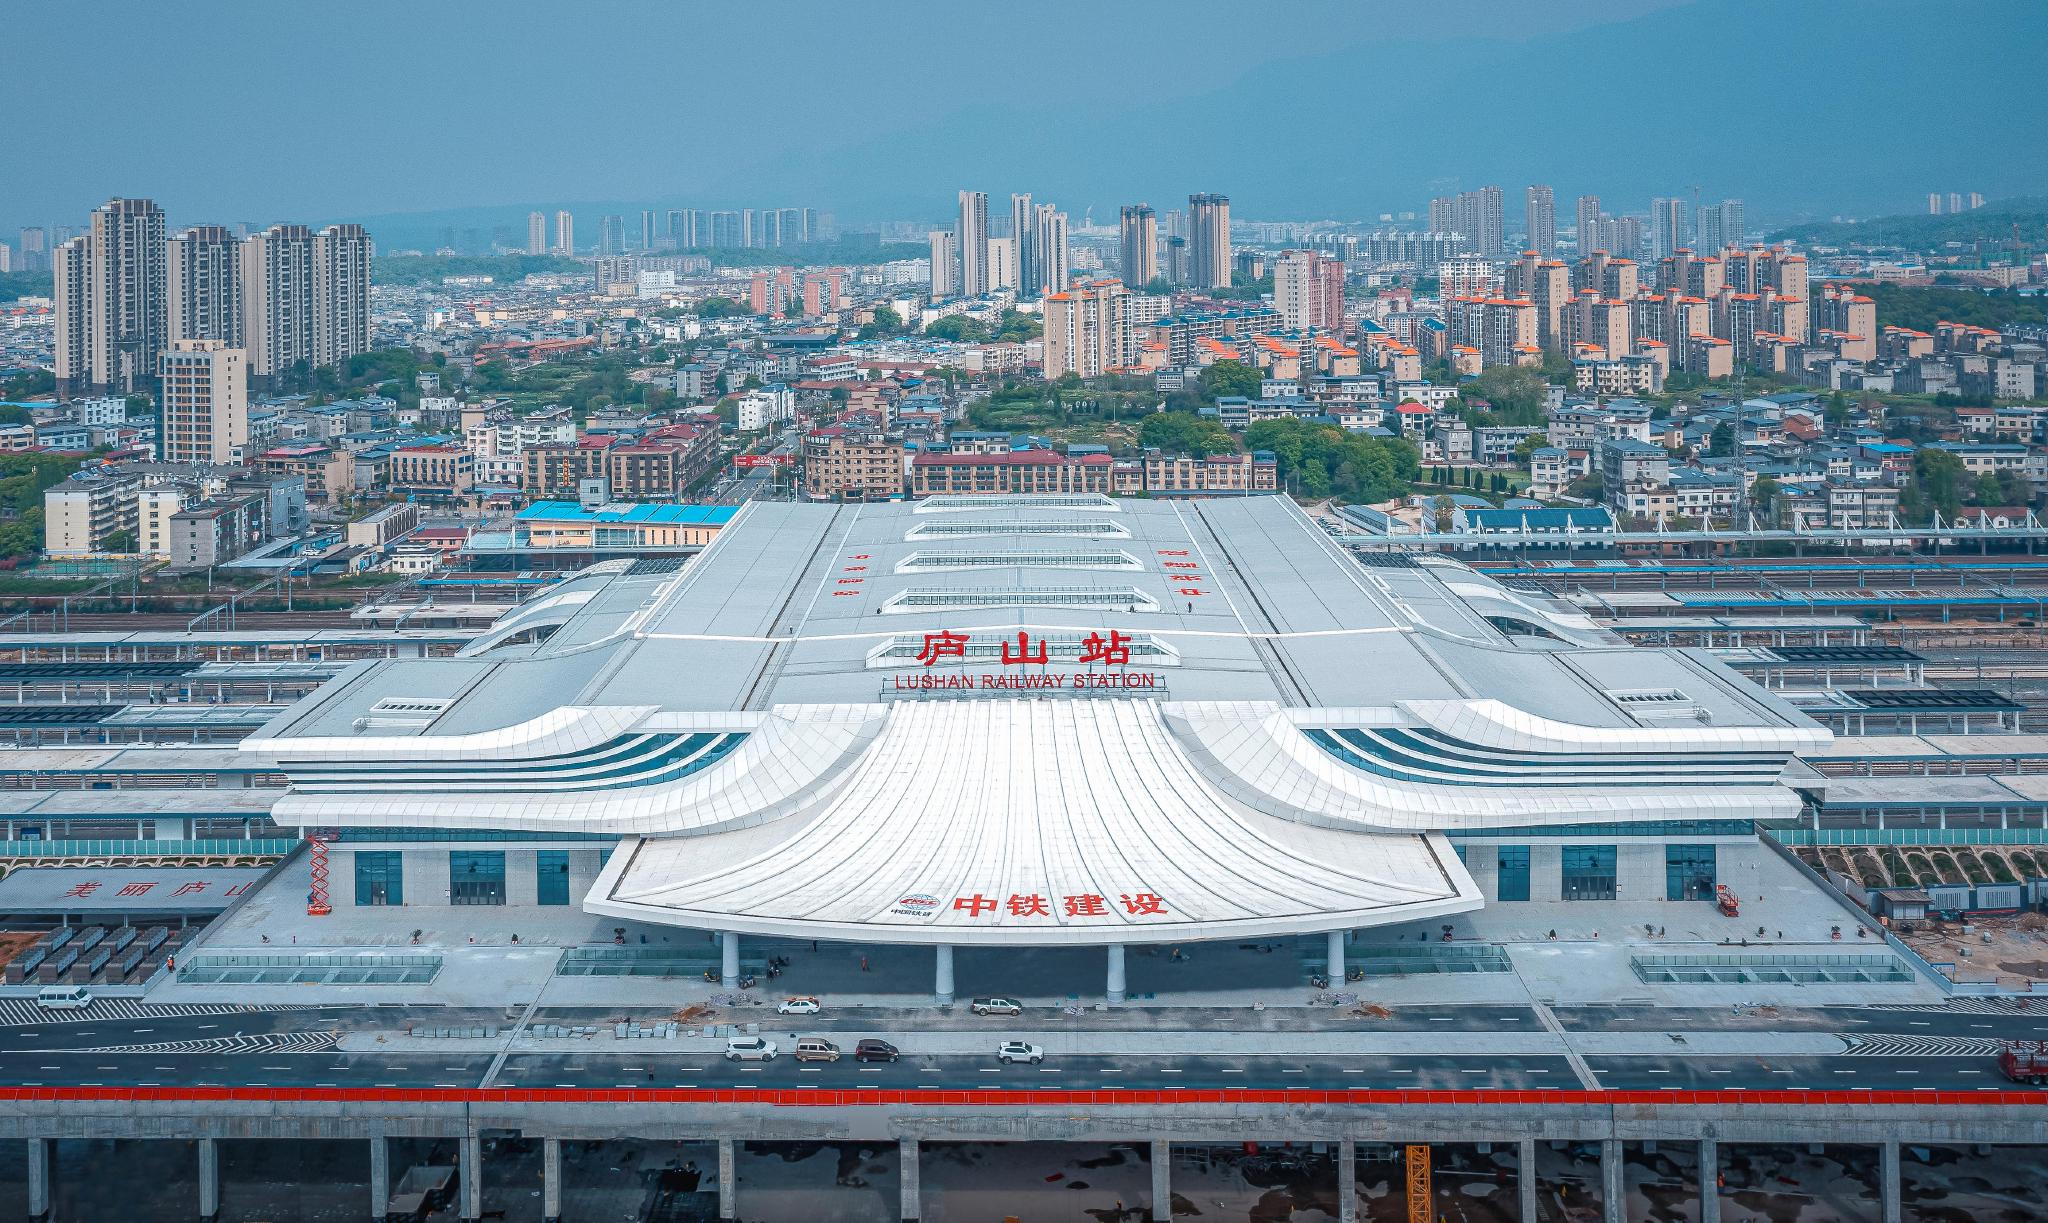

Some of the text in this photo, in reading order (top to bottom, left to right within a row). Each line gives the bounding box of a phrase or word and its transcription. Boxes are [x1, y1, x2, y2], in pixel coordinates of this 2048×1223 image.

[916, 630, 1132, 667] 庐山站
[895, 673, 1155, 689] LUSHAN RAILWAY STATION
[952, 893, 1168, 918] 中铁建设
